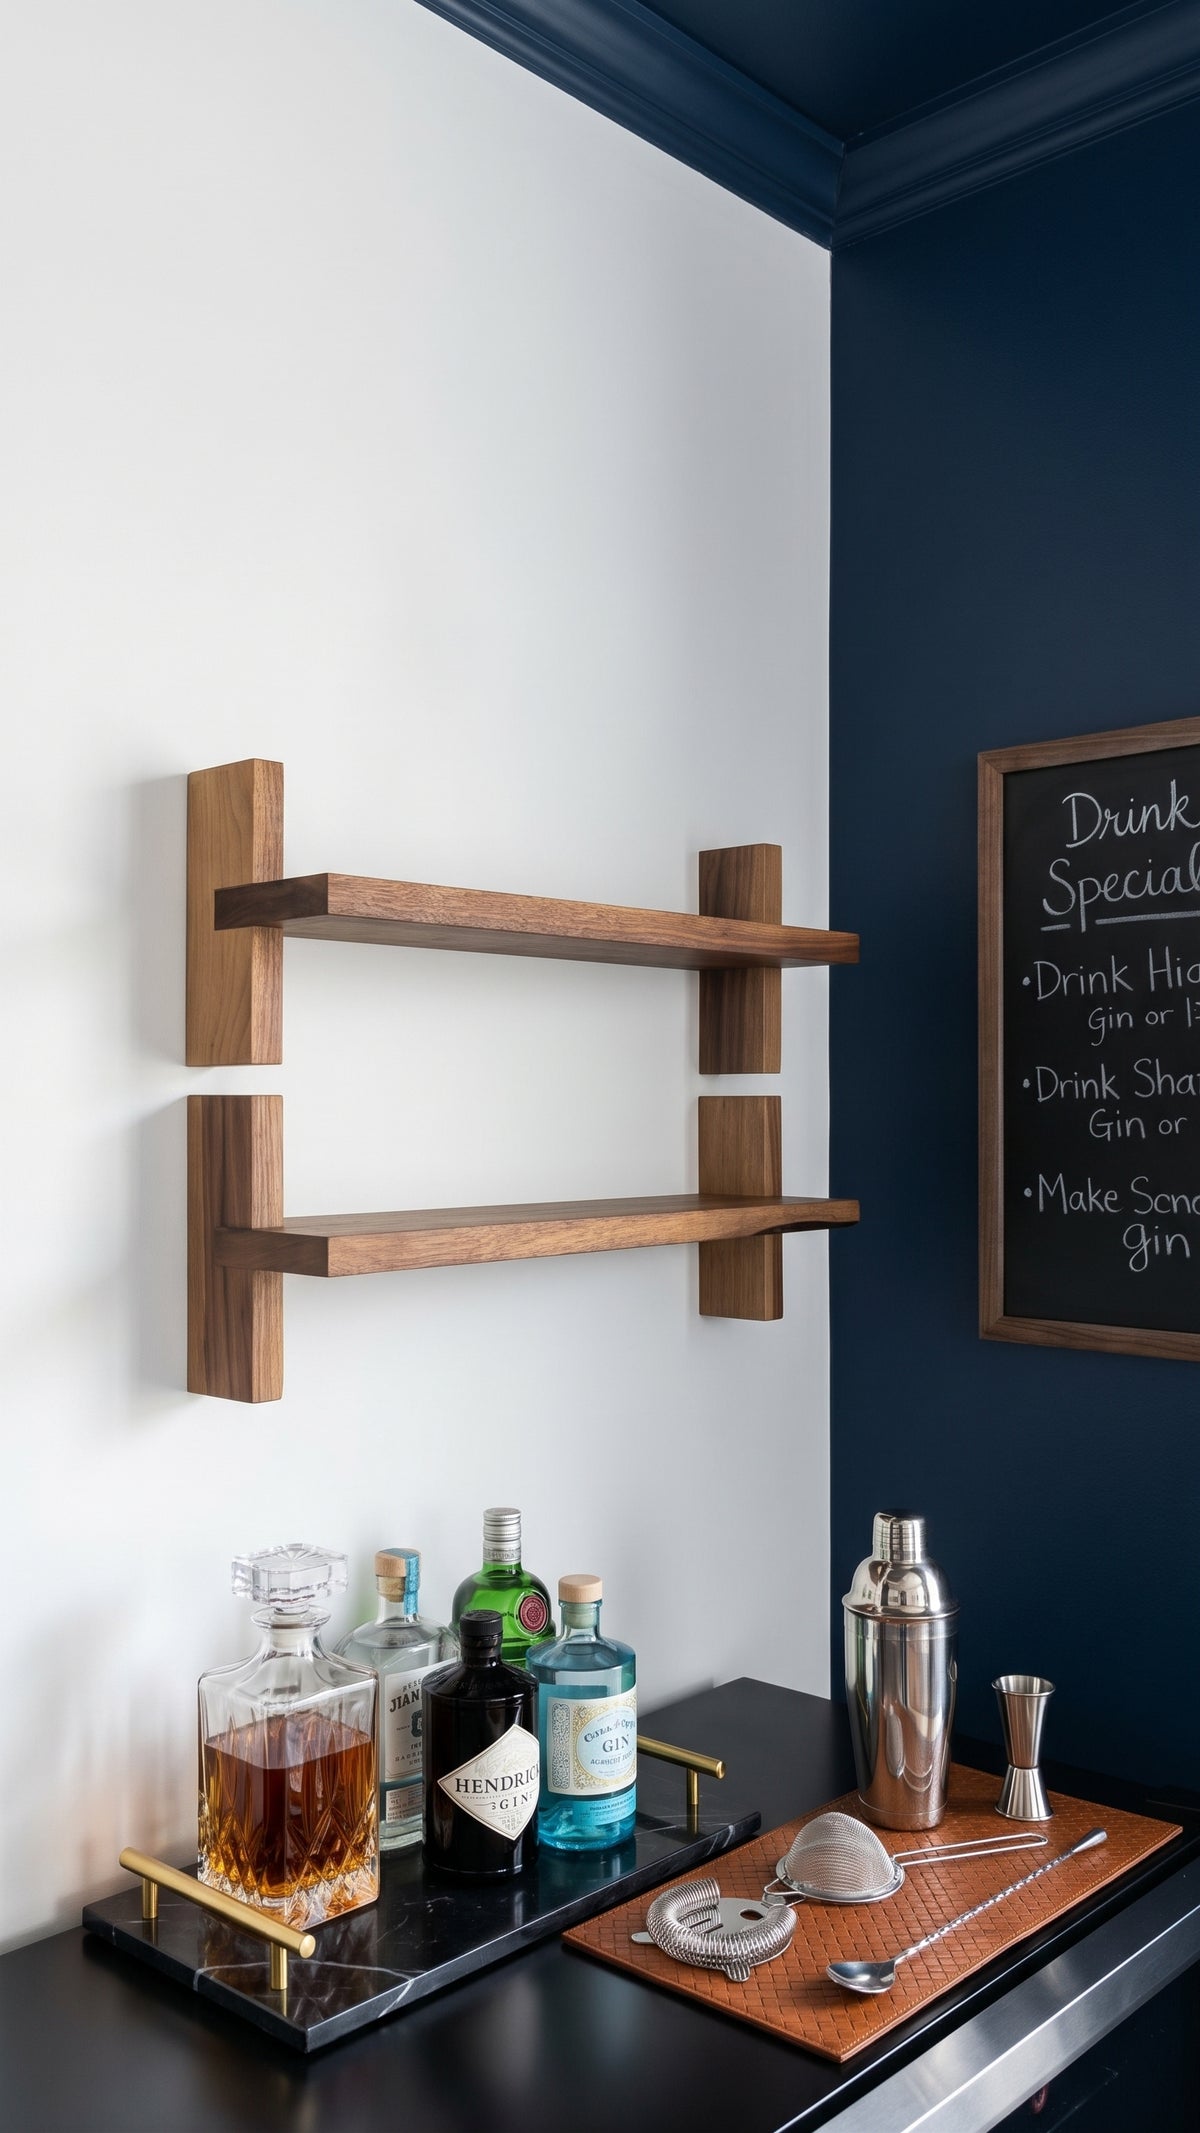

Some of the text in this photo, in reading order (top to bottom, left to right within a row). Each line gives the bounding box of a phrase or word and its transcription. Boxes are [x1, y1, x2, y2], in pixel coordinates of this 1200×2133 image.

[1062, 779, 1200, 848] Drink
[1043, 841, 1200, 933] Special
[1033, 954, 1133, 1000] Drink
[1088, 1007, 1133, 1047] Gin
[1145, 1009, 1174, 1025] or
[1035, 1058, 1200, 1102] Drink Sha
[1089, 1108, 1188, 1142] Gin or
[1038, 1173, 1123, 1214] Make
[1122, 1223, 1191, 1272] gin
[602, 1733, 629, 1753] GIN
[500, 1791, 529, 1810] GIN
